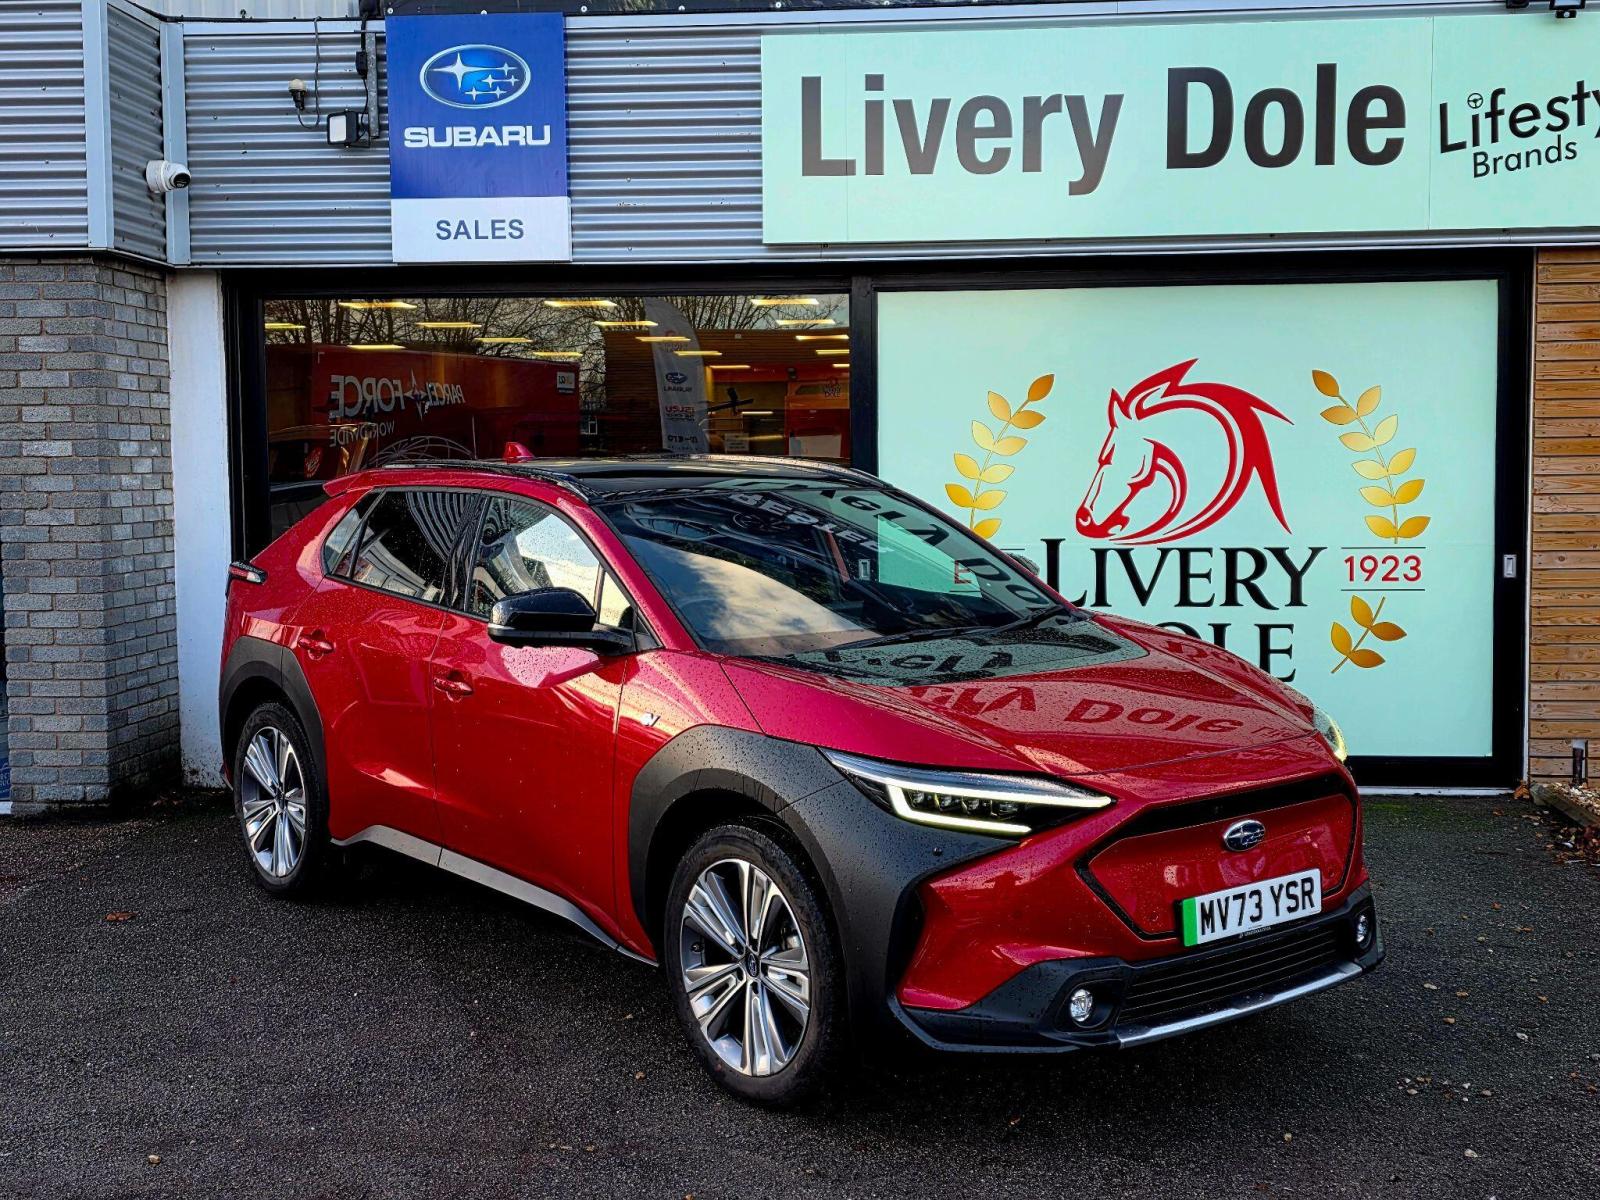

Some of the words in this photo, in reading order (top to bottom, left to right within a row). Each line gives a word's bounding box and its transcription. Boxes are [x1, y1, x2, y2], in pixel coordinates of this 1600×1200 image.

[404, 125, 551, 148] SUBARU
[801, 73, 1124, 196] Livery
[1166, 62, 1406, 169] Dole
[1473, 133, 1578, 179] Brands
[436, 219, 524, 240] SALES
[1040, 537, 1328, 610] LIVERY
[1344, 554, 1422, 582] 1923
[1201, 890, 1263, 936] MV73
[1270, 877, 1315, 917] YSR
